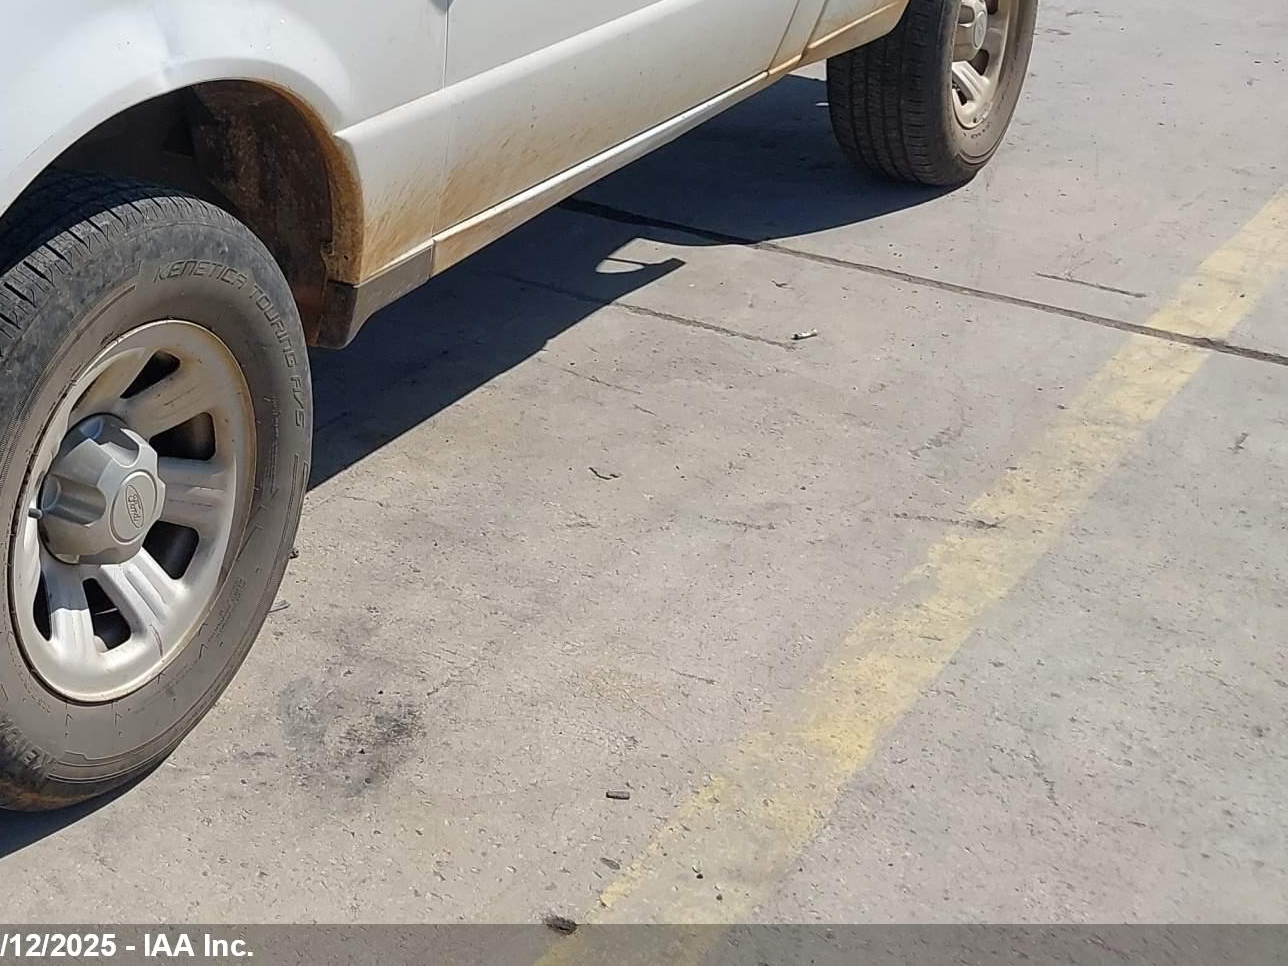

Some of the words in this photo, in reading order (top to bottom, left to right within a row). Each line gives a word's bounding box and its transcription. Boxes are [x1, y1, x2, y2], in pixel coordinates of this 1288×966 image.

[153, 259, 248, 290] KENETICA
[249, 285, 297, 368] TOURING
[128, 494, 142, 522] Ford
